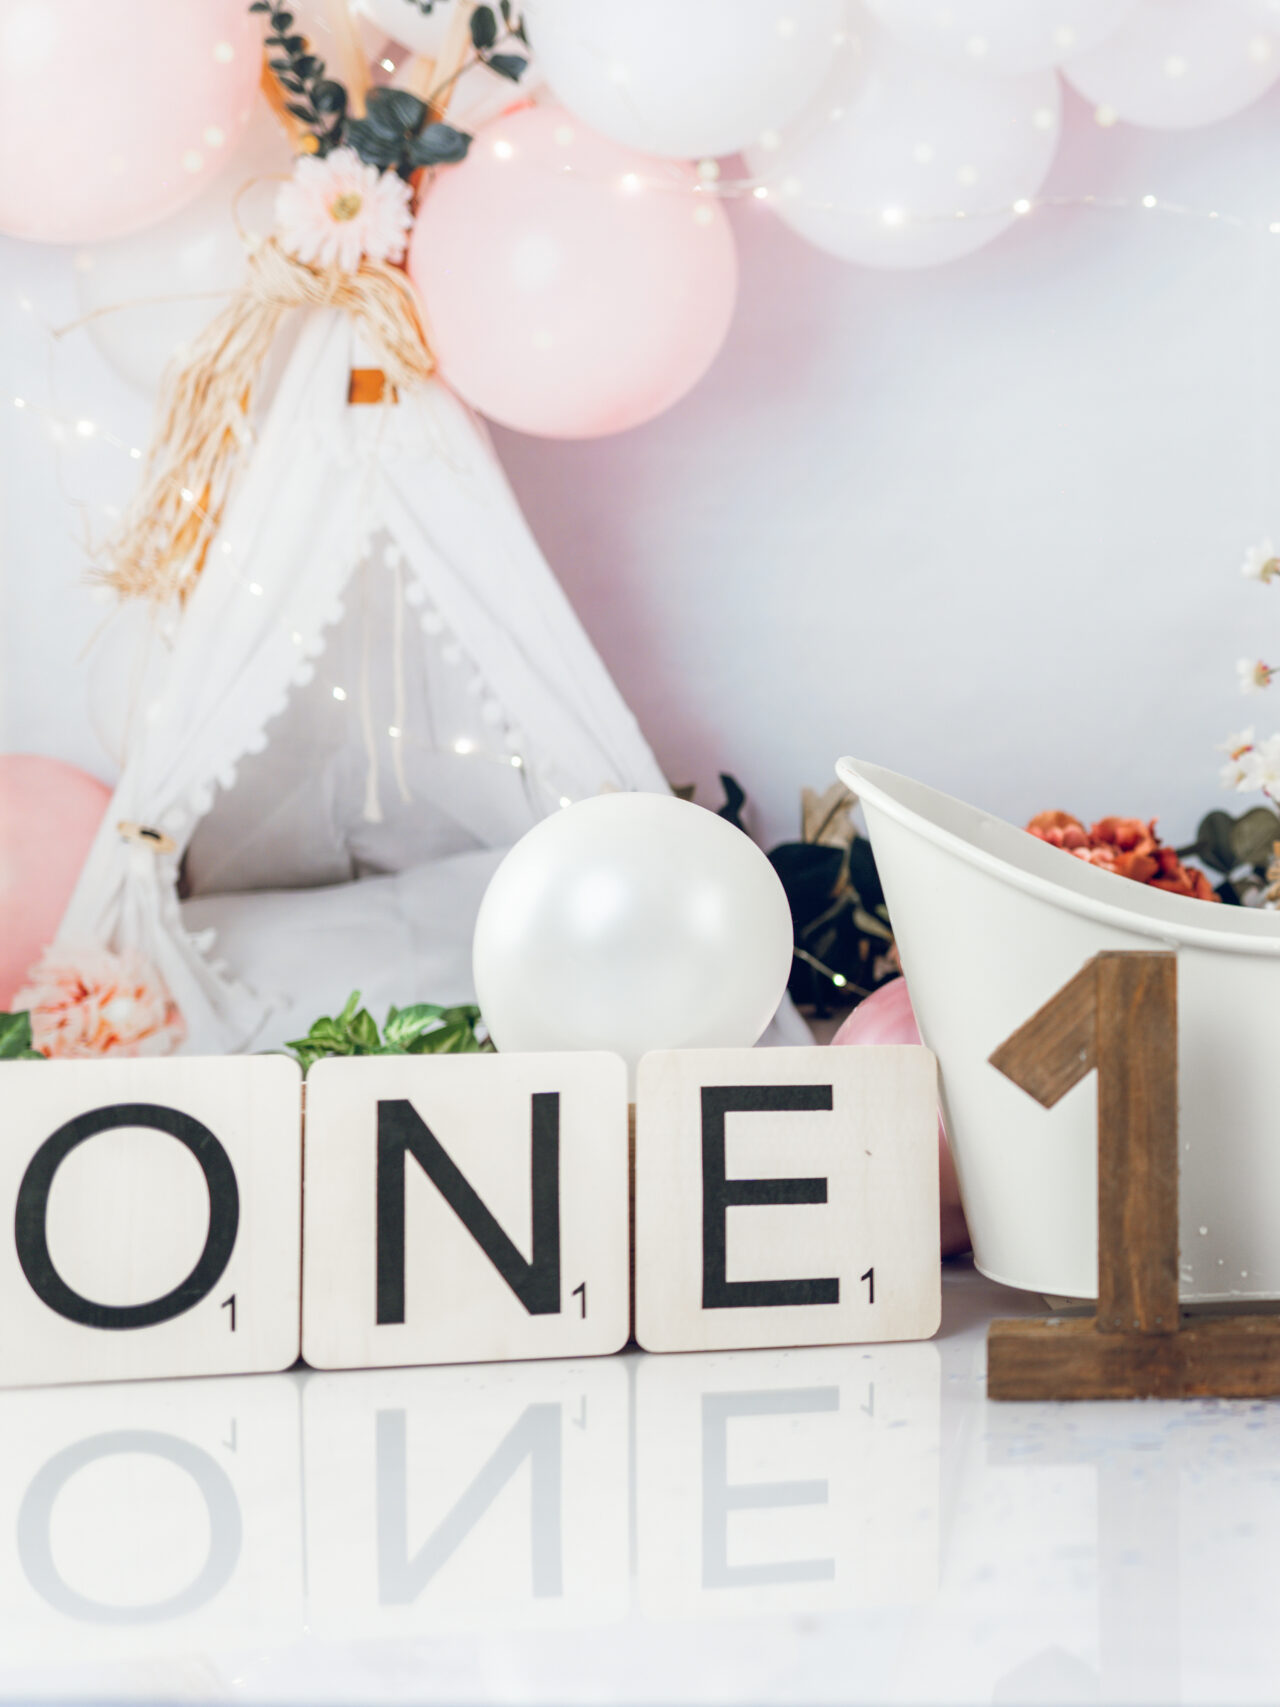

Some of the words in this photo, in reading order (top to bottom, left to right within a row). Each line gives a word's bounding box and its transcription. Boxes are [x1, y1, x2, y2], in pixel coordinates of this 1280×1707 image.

[570, 1281, 587, 1320] 1
[858, 1267, 876, 1305] 1
[220, 1294, 237, 1332] 1
